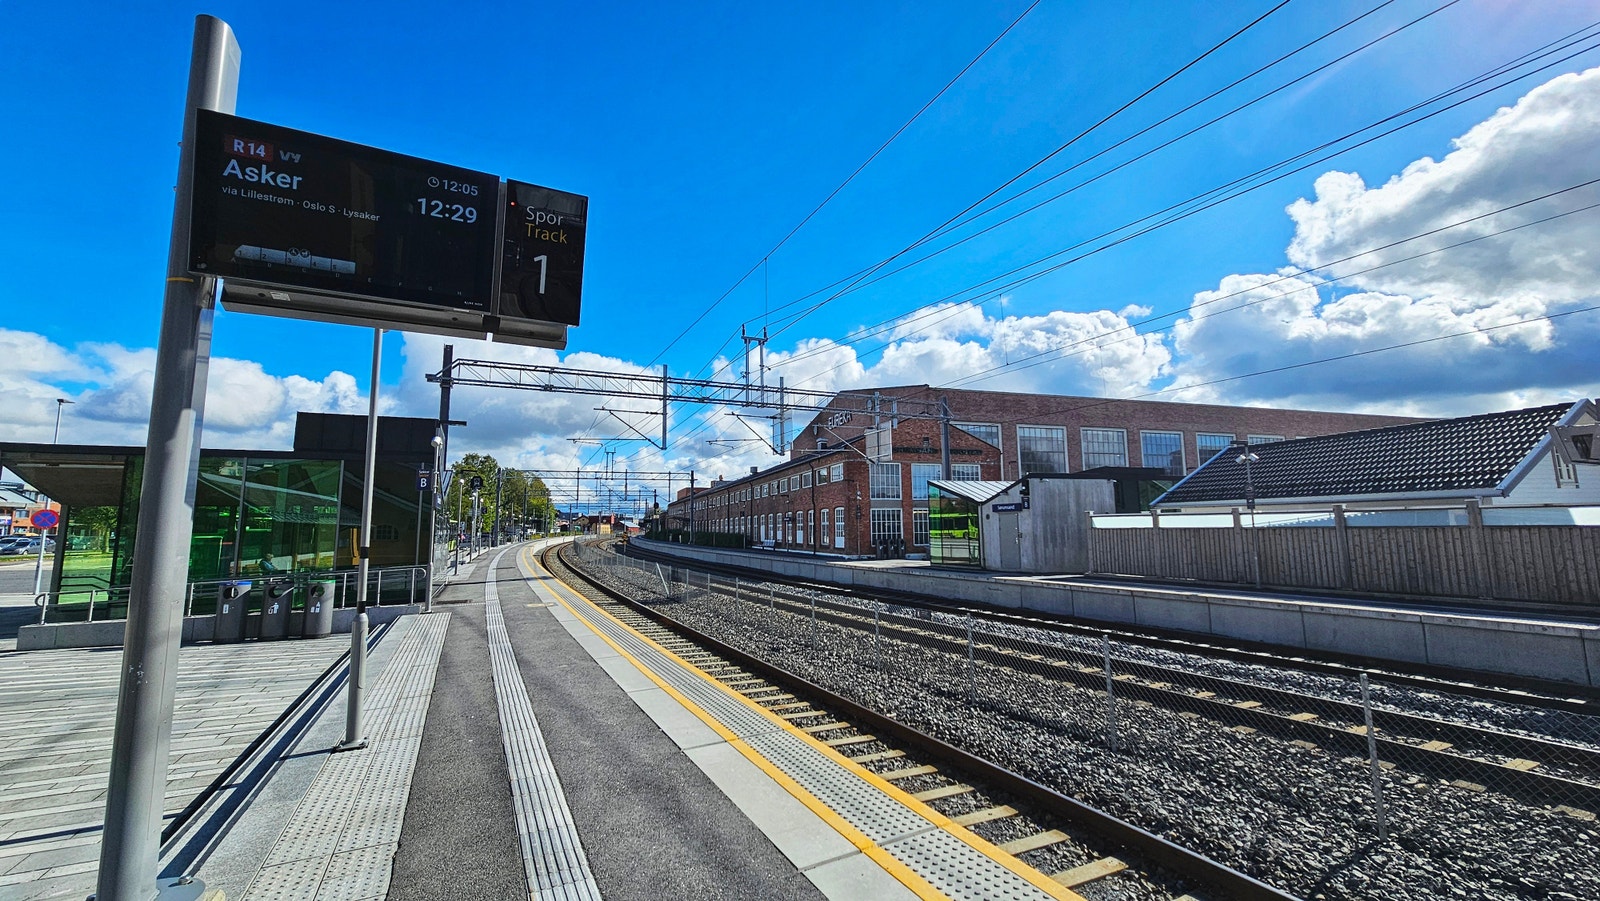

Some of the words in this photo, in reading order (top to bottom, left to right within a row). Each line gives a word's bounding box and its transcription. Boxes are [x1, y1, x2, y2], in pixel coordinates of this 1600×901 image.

[222, 158, 303, 190] Asker
[442, 179, 479, 196] 12:05
[222, 186, 238, 195] via
[241, 188, 294, 206] Lillestrøm
[303, 200, 326, 212] Oslo
[328, 205, 336, 213] S
[343, 207, 381, 221] Lysaker
[417, 197, 478, 224] 12:29
[525, 205, 564, 226] Spor
[525, 222, 568, 244] Track
[533, 254, 548, 295] 1
[420, 478, 427, 488] B
